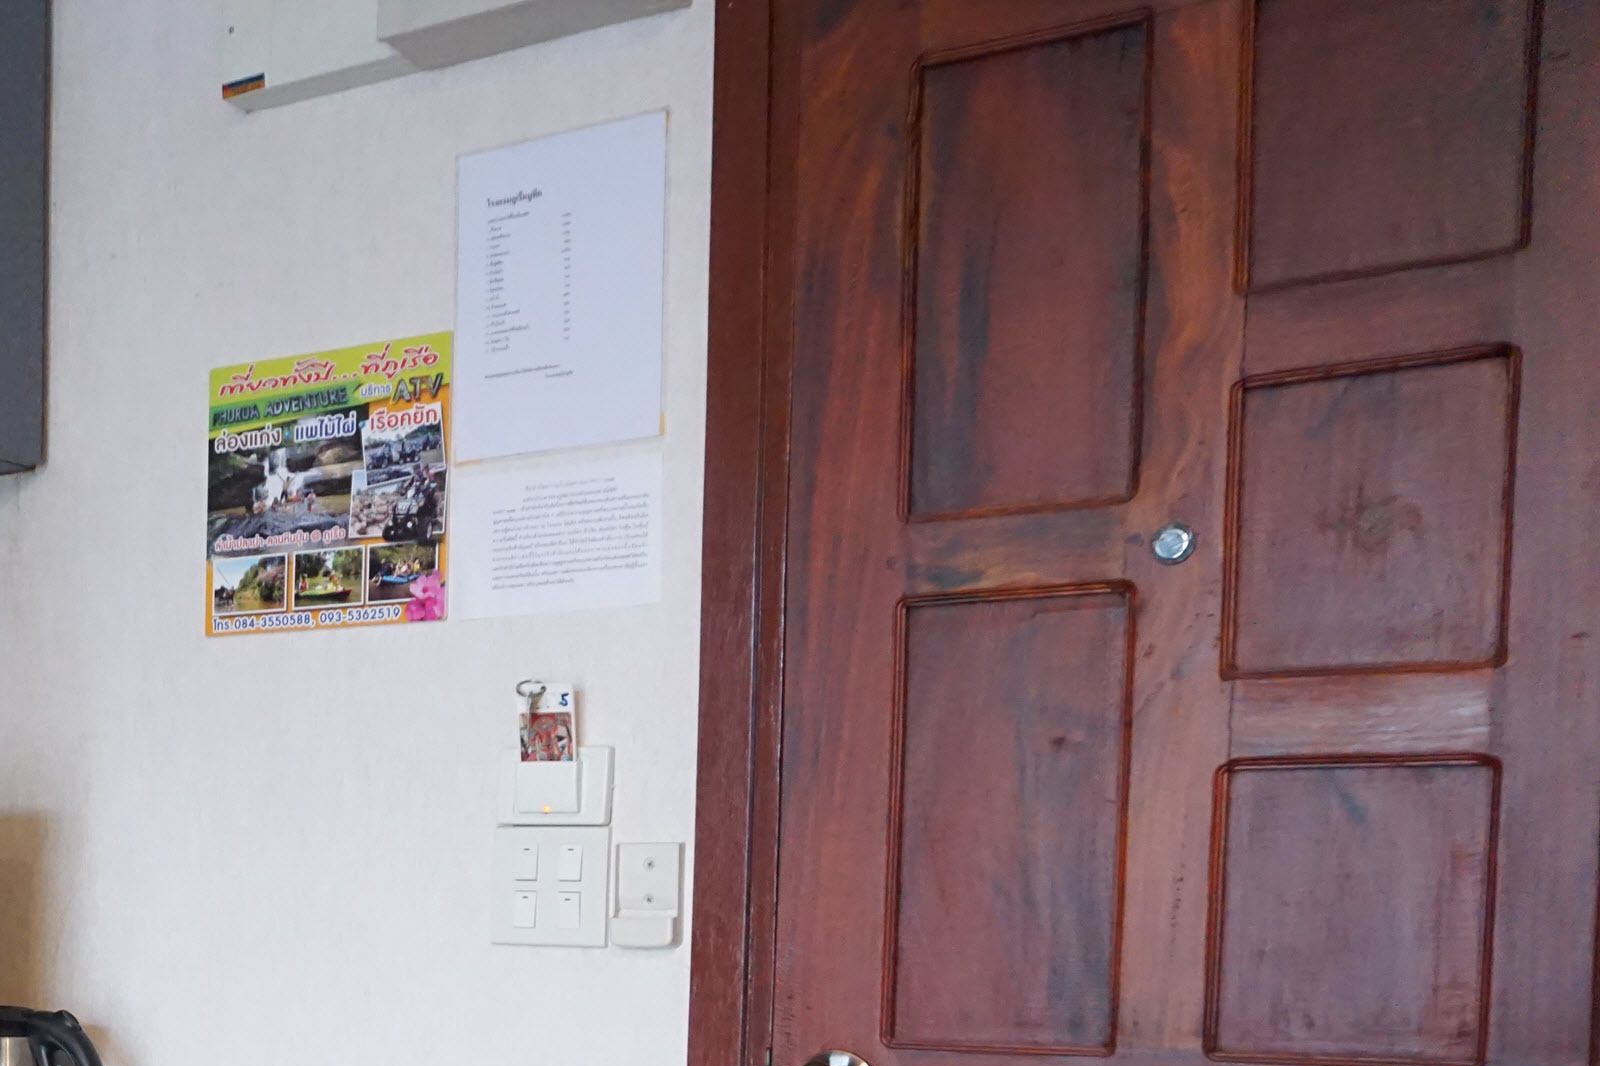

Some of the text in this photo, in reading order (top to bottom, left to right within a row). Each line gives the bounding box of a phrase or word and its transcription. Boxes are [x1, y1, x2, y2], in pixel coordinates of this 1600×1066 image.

[360, 372, 444, 404] บริการ ATV
[212, 386, 349, 427] PHURUA ADVENTURE
[215, 425, 282, 453] ล่องแก่ง
[294, 411, 357, 441] แพไม้ไผ่
[319, 607, 401, 624] 093-5362519
[559, 692, 569, 707] 5
